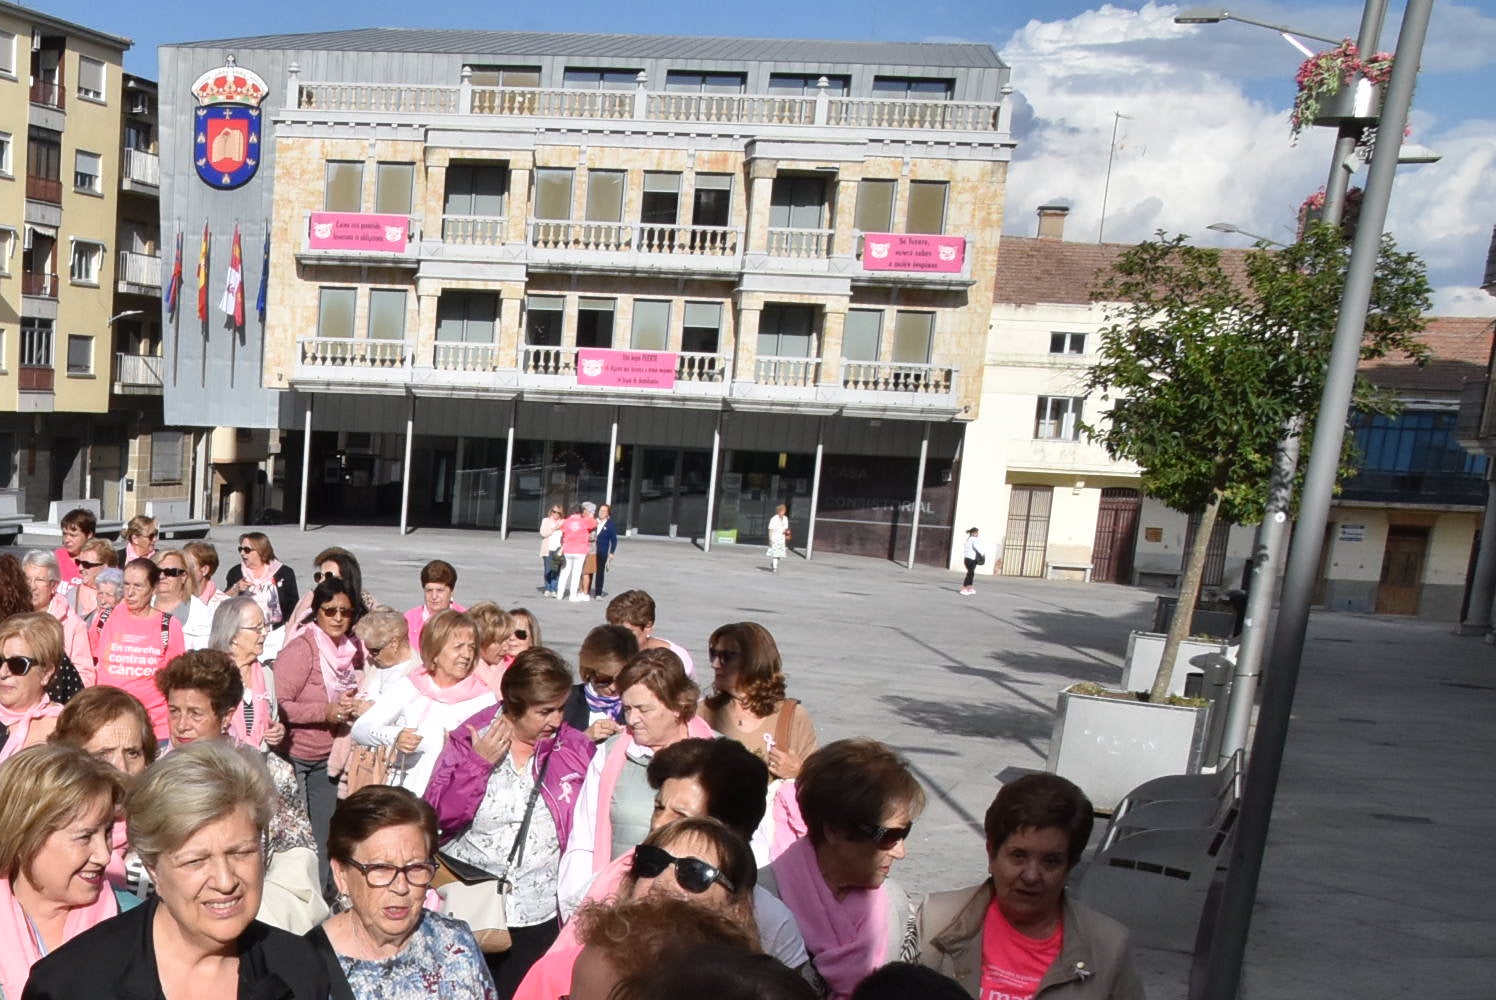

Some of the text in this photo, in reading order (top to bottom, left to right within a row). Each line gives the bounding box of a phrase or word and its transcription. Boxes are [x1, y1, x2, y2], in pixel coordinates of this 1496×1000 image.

[110, 643, 161, 656] En marcha
[108, 654, 146, 665] contra
[108, 662, 158, 677] cáncer
